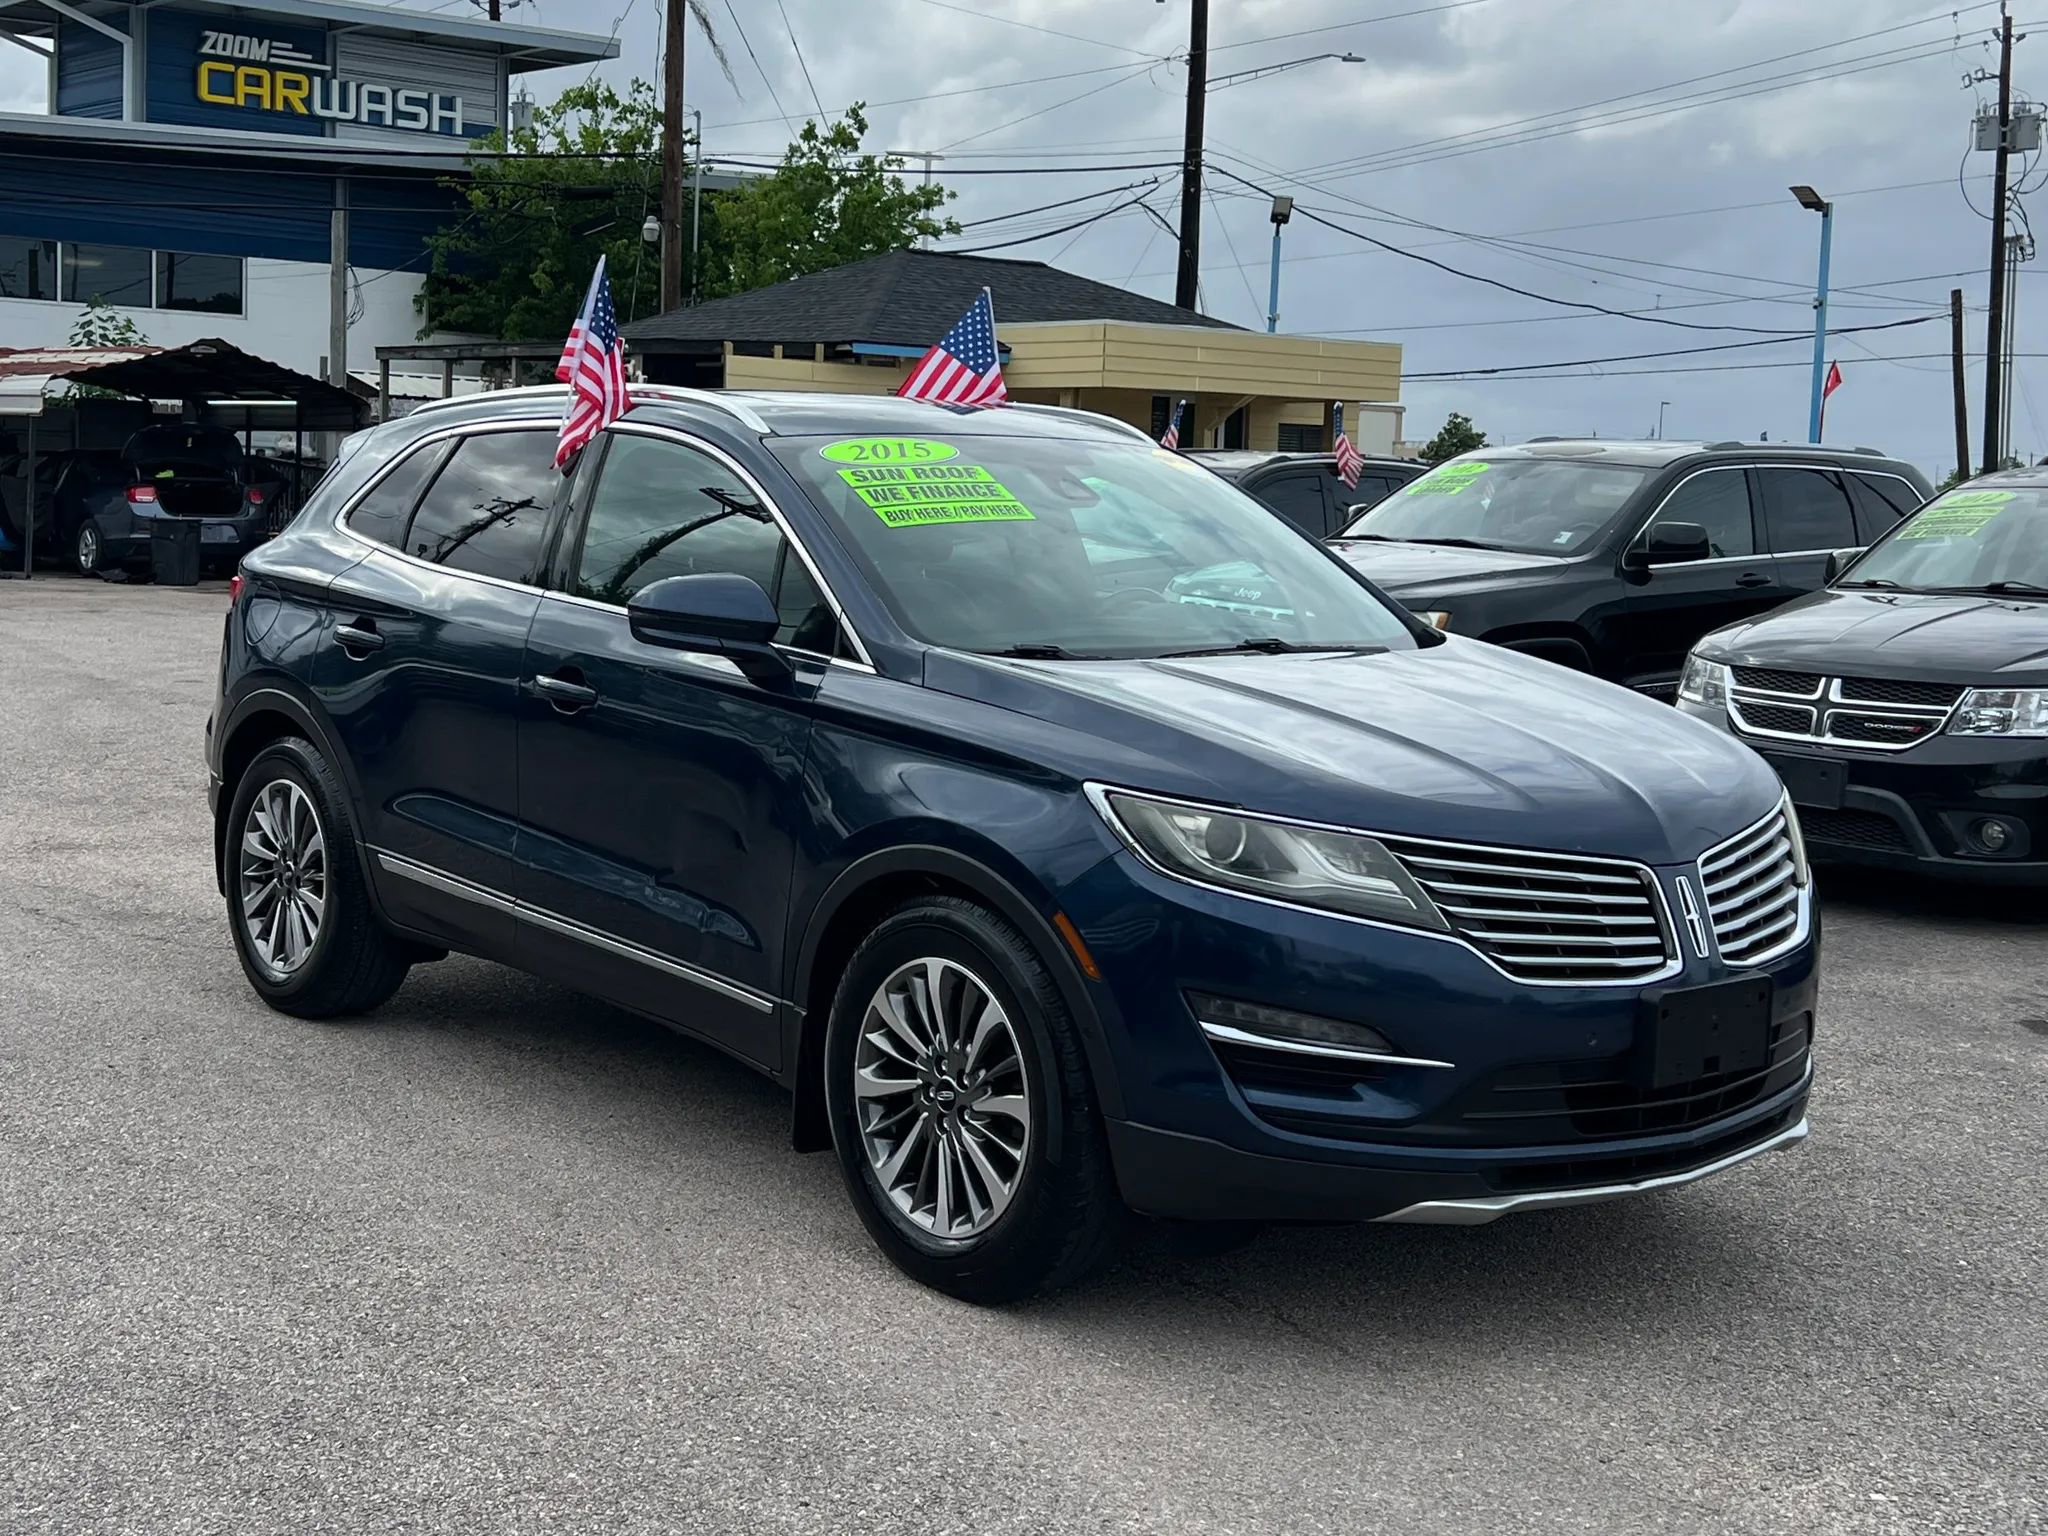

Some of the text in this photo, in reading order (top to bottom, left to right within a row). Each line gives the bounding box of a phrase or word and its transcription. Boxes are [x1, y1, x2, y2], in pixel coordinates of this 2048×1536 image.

[200, 31, 270, 61] ZOOM
[848, 442, 931, 461] 2015
[851, 466, 979, 482] SUN ROOF
[866, 484, 1001, 503] WE FINANCE
[884, 509, 912, 522] BUY
[915, 507, 952, 519] HERE
[963, 505, 985, 517] PAY
[987, 504, 1022, 516] HERE
[1234, 587, 1261, 600] Jeep
